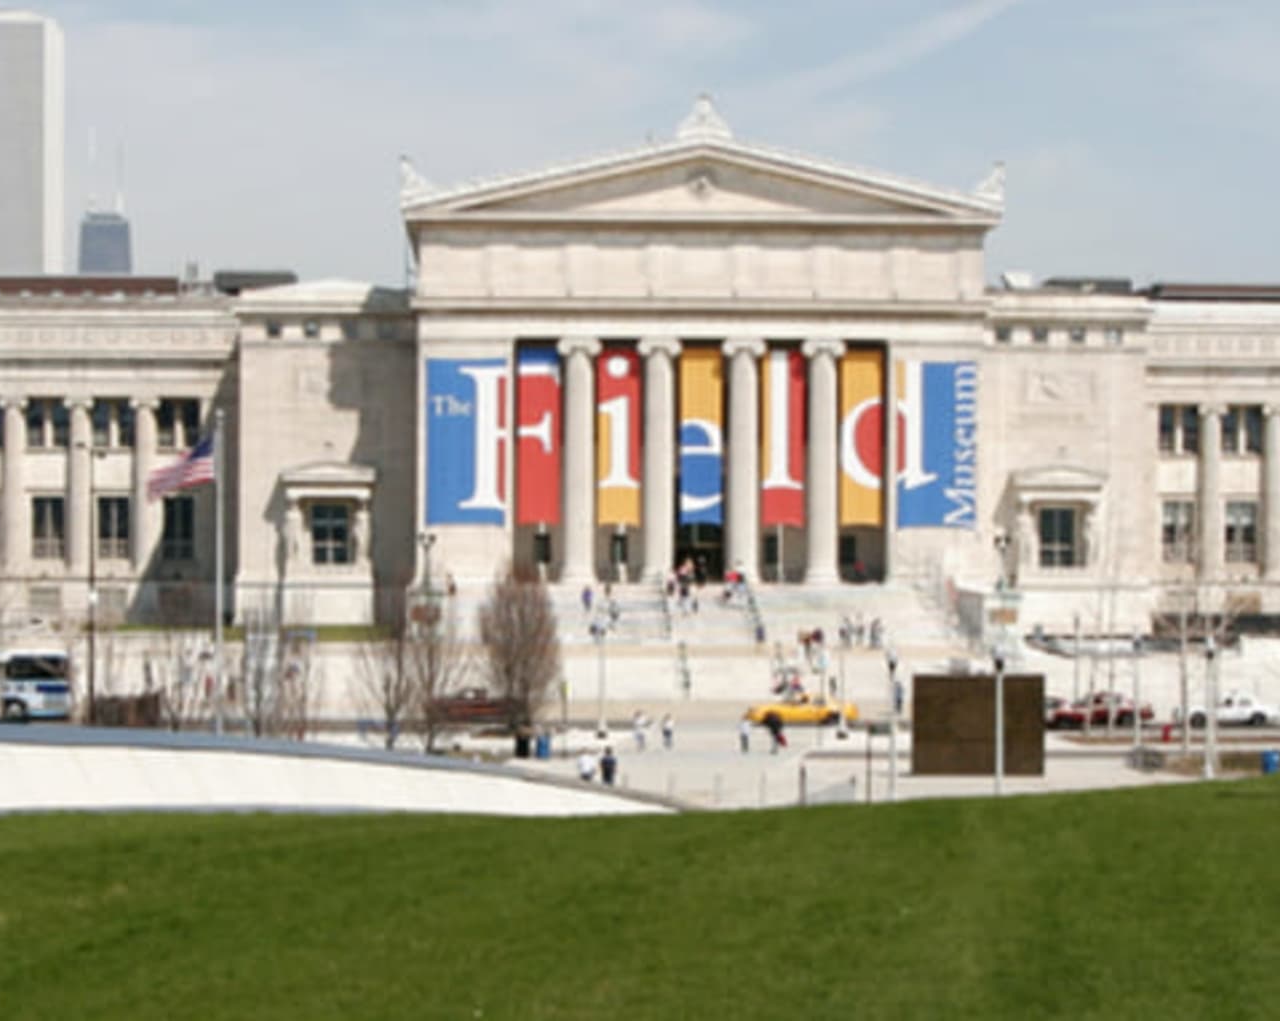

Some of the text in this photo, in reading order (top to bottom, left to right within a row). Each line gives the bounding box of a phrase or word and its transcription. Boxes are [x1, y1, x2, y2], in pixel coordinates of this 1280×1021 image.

[431, 350, 938, 513] The Field
[943, 364, 977, 531] Museum
